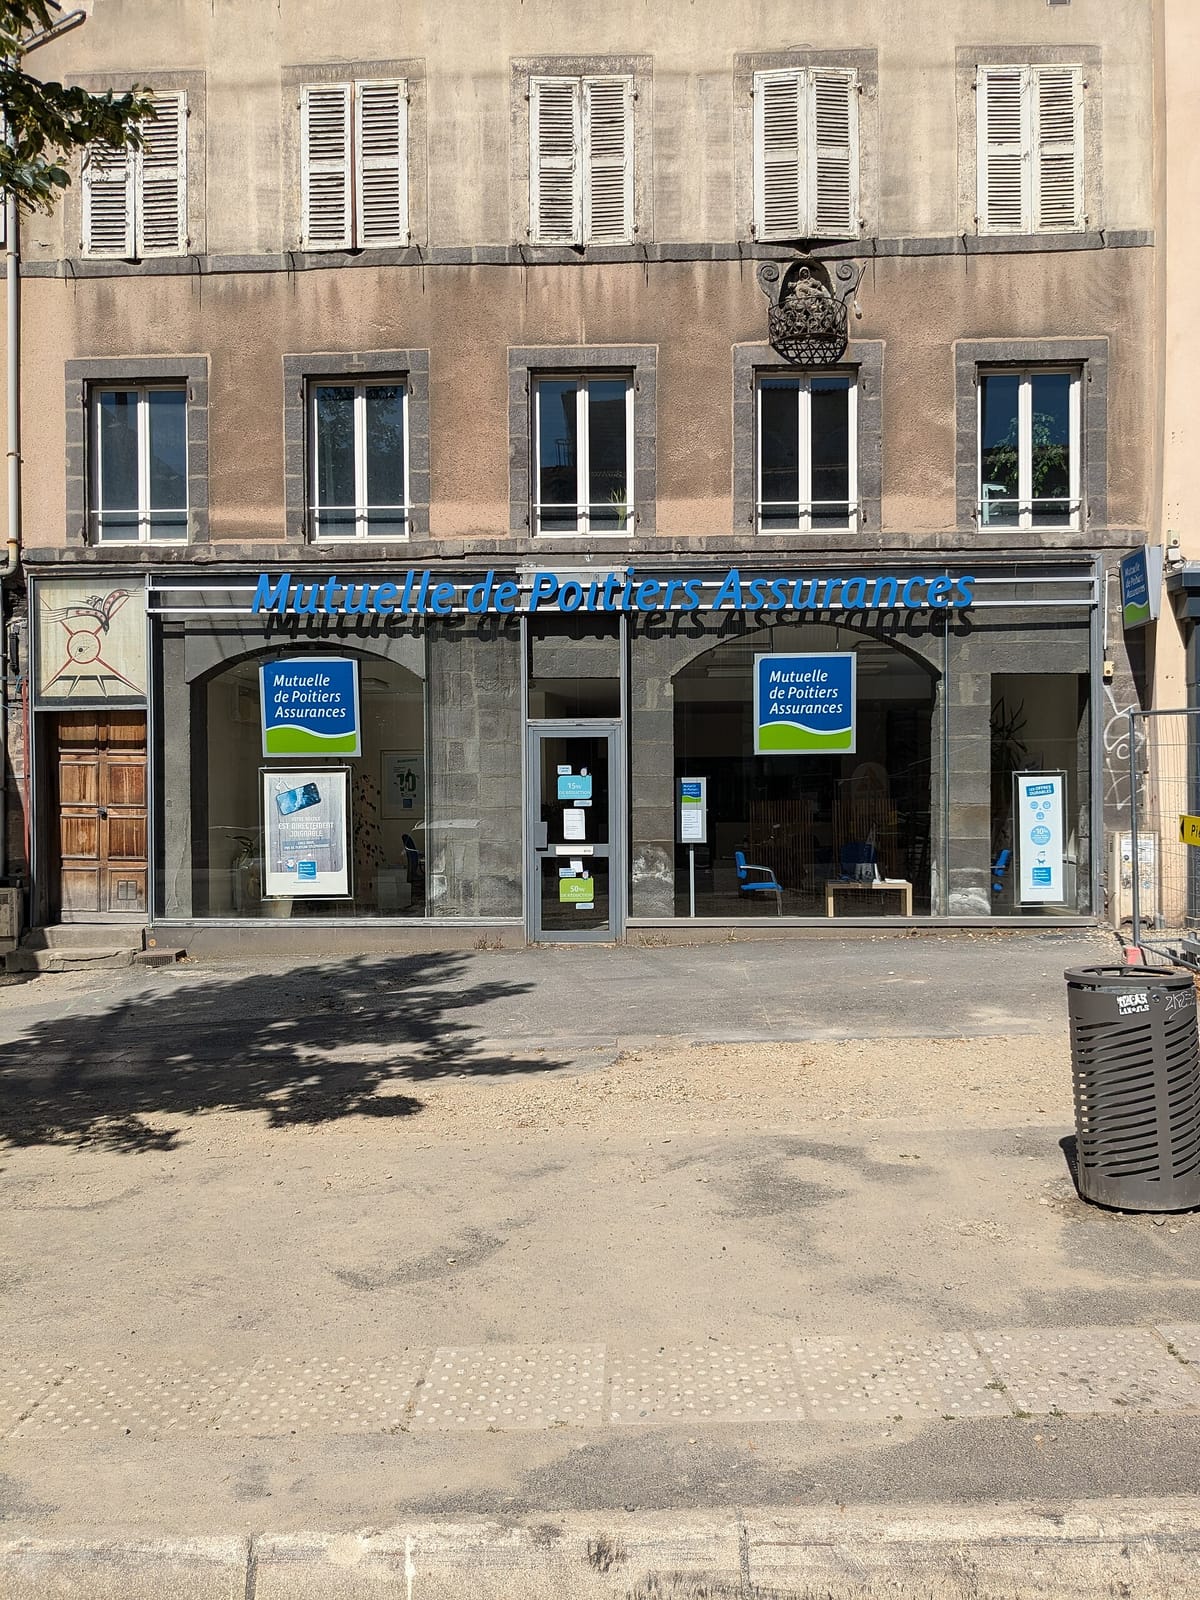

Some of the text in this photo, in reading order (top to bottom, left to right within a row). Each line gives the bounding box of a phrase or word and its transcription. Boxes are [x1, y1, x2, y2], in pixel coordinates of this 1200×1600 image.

[252, 567, 976, 614] Mutuelle de Poitiers Assurances
[273, 673, 331, 687] Mutuelle
[769, 669, 829, 683] Mutuelle
[274, 690, 341, 703] de Poitiers
[769, 685, 838, 699] de Poitiers
[274, 705, 347, 718] Assurances
[769, 702, 843, 715] Assurances
